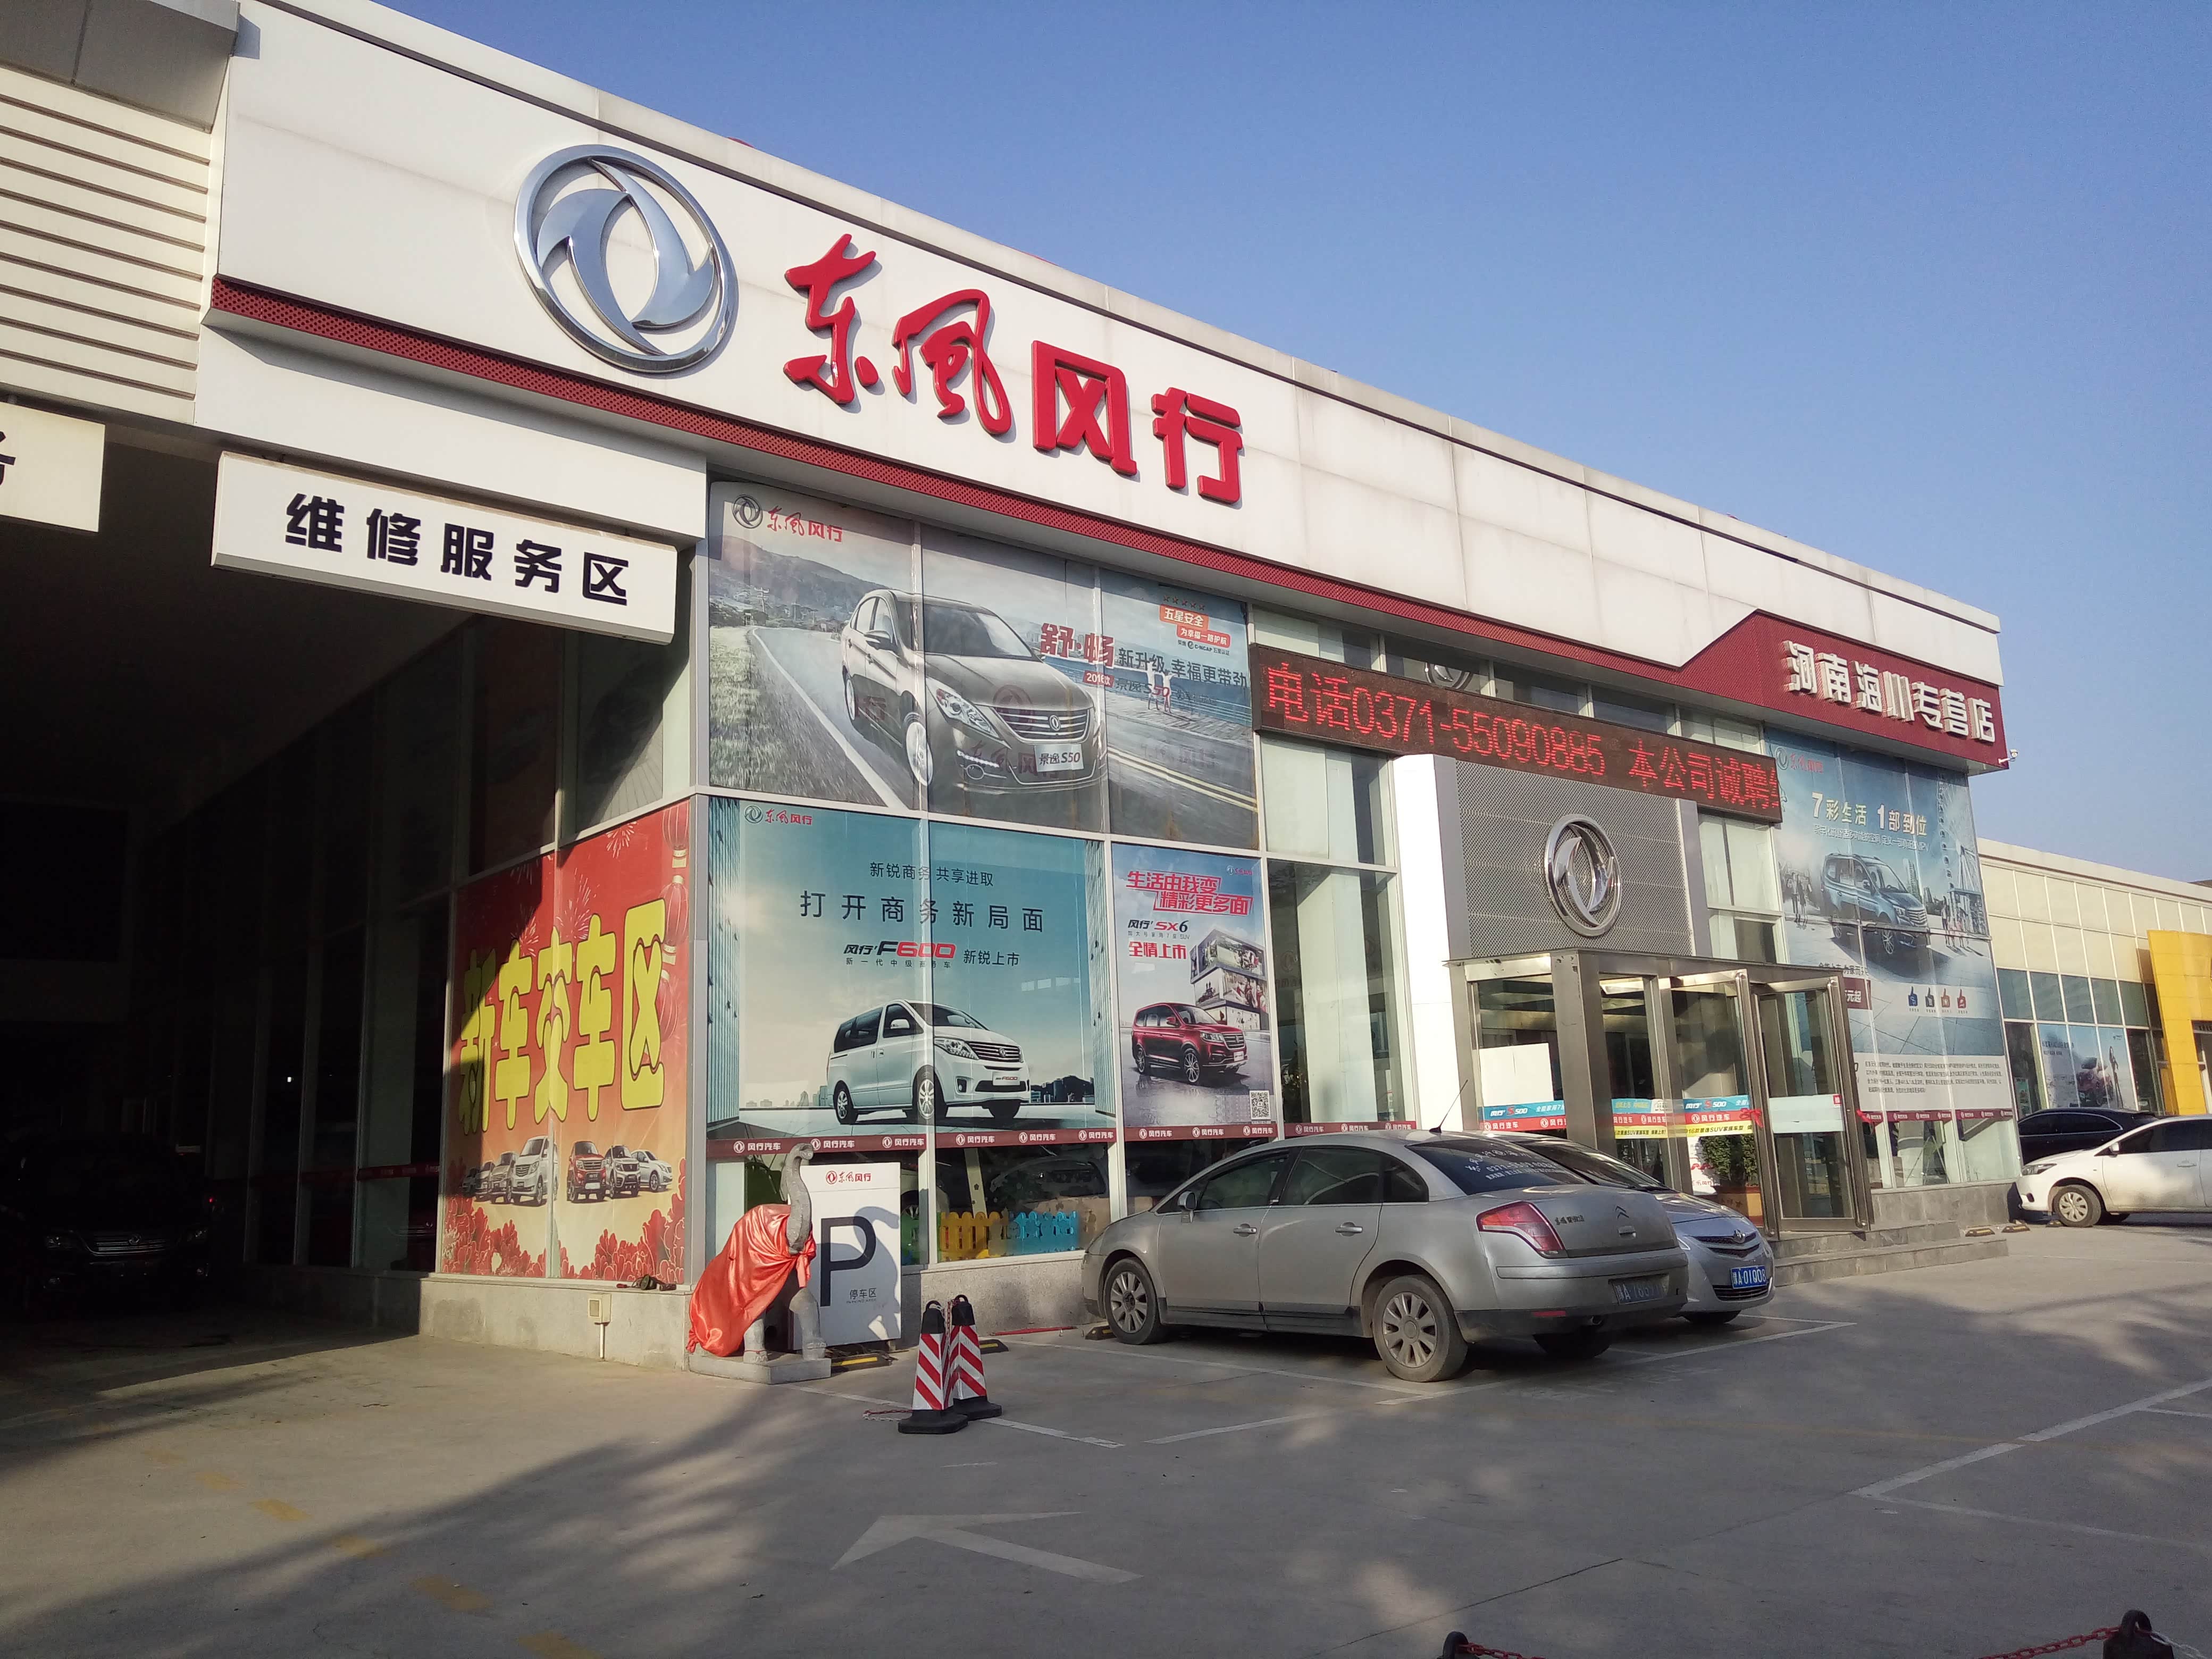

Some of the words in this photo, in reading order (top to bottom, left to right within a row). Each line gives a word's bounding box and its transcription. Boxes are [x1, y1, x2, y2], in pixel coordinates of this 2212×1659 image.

[783, 233, 1243, 504] 东风风行
[767, 506, 843, 542] 东风风行
[284, 492, 630, 607] 维修服务区
[1164, 608, 1204, 627] 五星安全
[1180, 627, 1227, 645] 为幸福一路护航
[1783, 640, 1996, 743] 河南海川专营店
[870, 862, 930, 881] 新锐商务
[936, 867, 993, 887] 共享进取
[1126, 871, 1218, 894] 生活由我变
[800, 890, 1043, 933] 打开商务新局面
[1160, 891, 1247, 915] 精彩更多面
[963, 949, 1020, 966] 新锐上市
[1129, 942, 1186, 959] 全情上市
[458, 898, 666, 1135] 新车交车区
[748, 1142, 781, 1151] 风行汽车
[824, 1139, 855, 1149] 风行汽车
[895, 1137, 925, 1146] 风行汽车
[838, 1171, 871, 1183] 东风风行
[820, 1216, 876, 1307] P
[850, 1287, 877, 1300] 停车区
